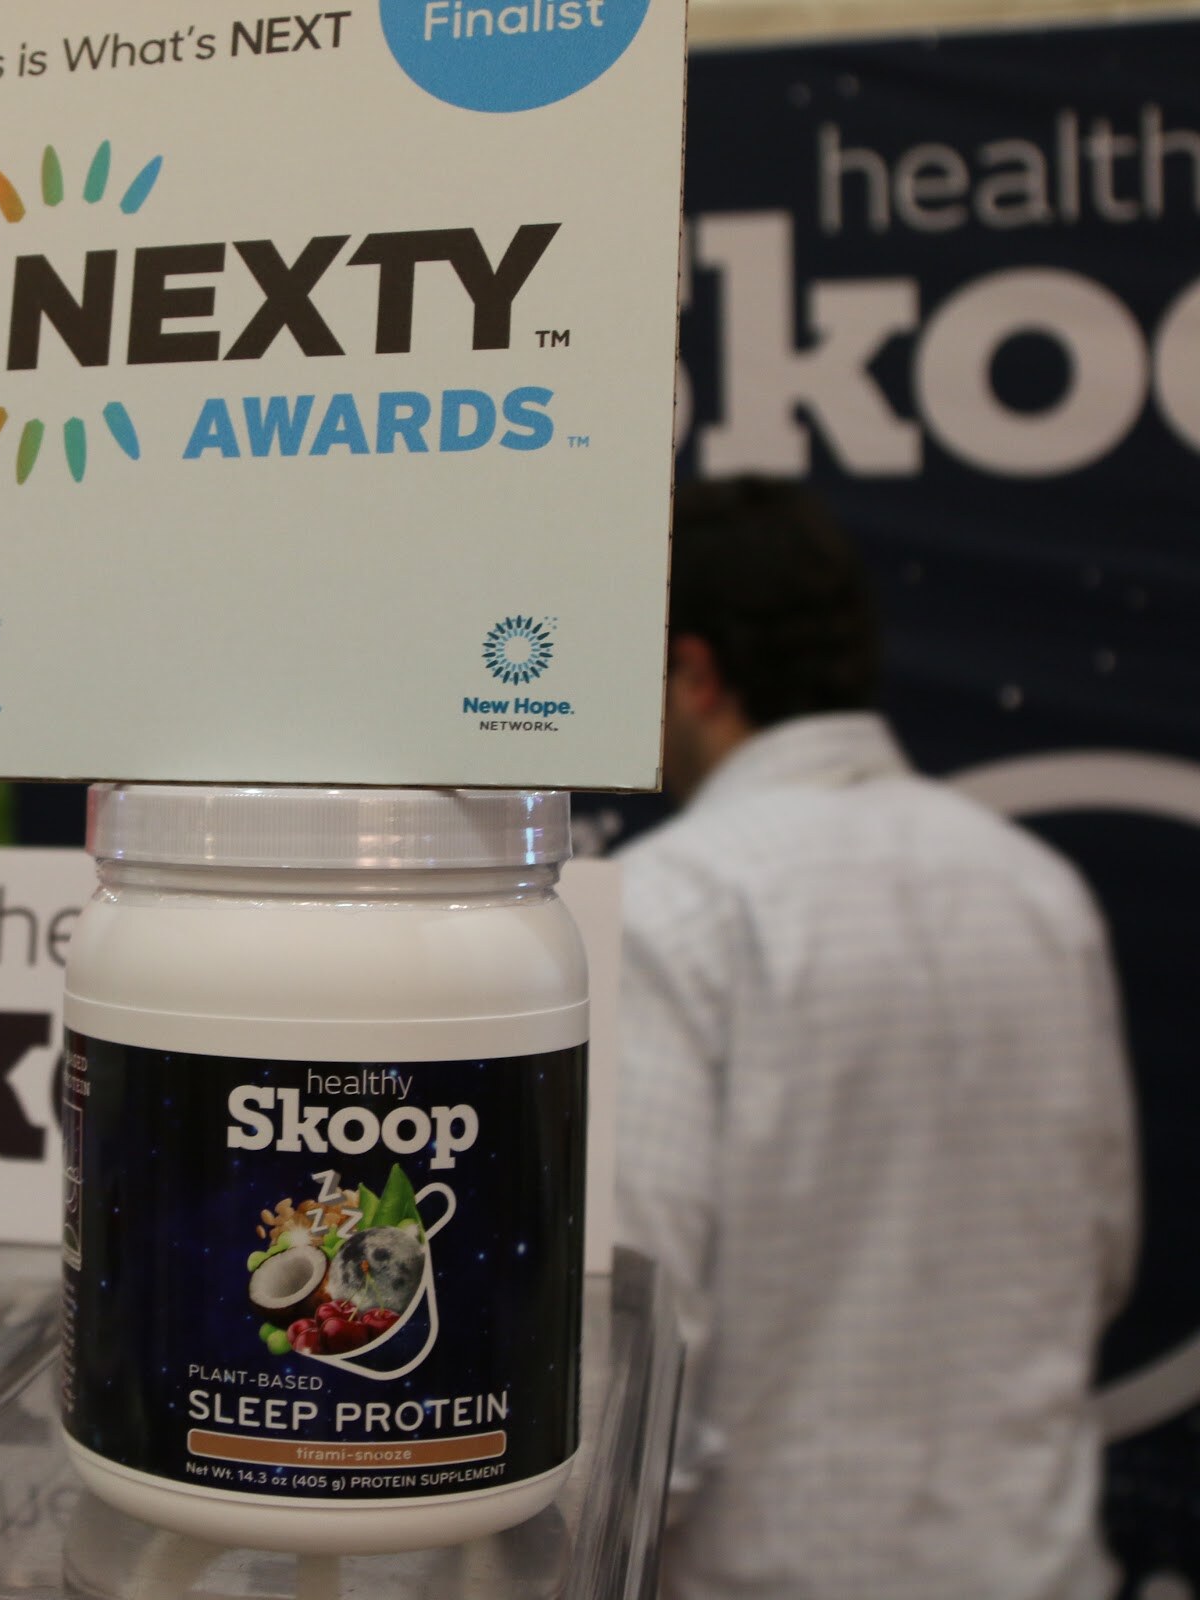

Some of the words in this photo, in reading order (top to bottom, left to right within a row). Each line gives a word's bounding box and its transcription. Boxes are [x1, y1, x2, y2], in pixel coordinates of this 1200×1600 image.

[424, 0, 604, 41] Finalist
[17, 42, 48, 78] is
[62, 25, 216, 72] What's
[231, 11, 352, 57] NEXT
[6, 222, 562, 371] NEXTY
[674, 208, 1200, 481] ko
[182, 386, 555, 460] AWARDS
[463, 697, 509, 714] New
[307, 1068, 413, 1100] healthy
[227, 1084, 479, 1170] Skoop
[188, 1364, 323, 1391] PLANT-BASED
[187, 1389, 319, 1431] SLEEP
[335, 1390, 508, 1433] PROTEIN
[186, 1461, 208, 1475] Net
[212, 1465, 234, 1481] Wt.
[237, 1470, 268, 1484] 14.3
[271, 1476, 287, 1486] oz
[292, 1475, 327, 1489] (405
[331, 1476, 346, 1491] g)
[351, 1476, 416, 1489] PROTEIN
[420, 1463, 506, 1487] SUPPLEMENT
